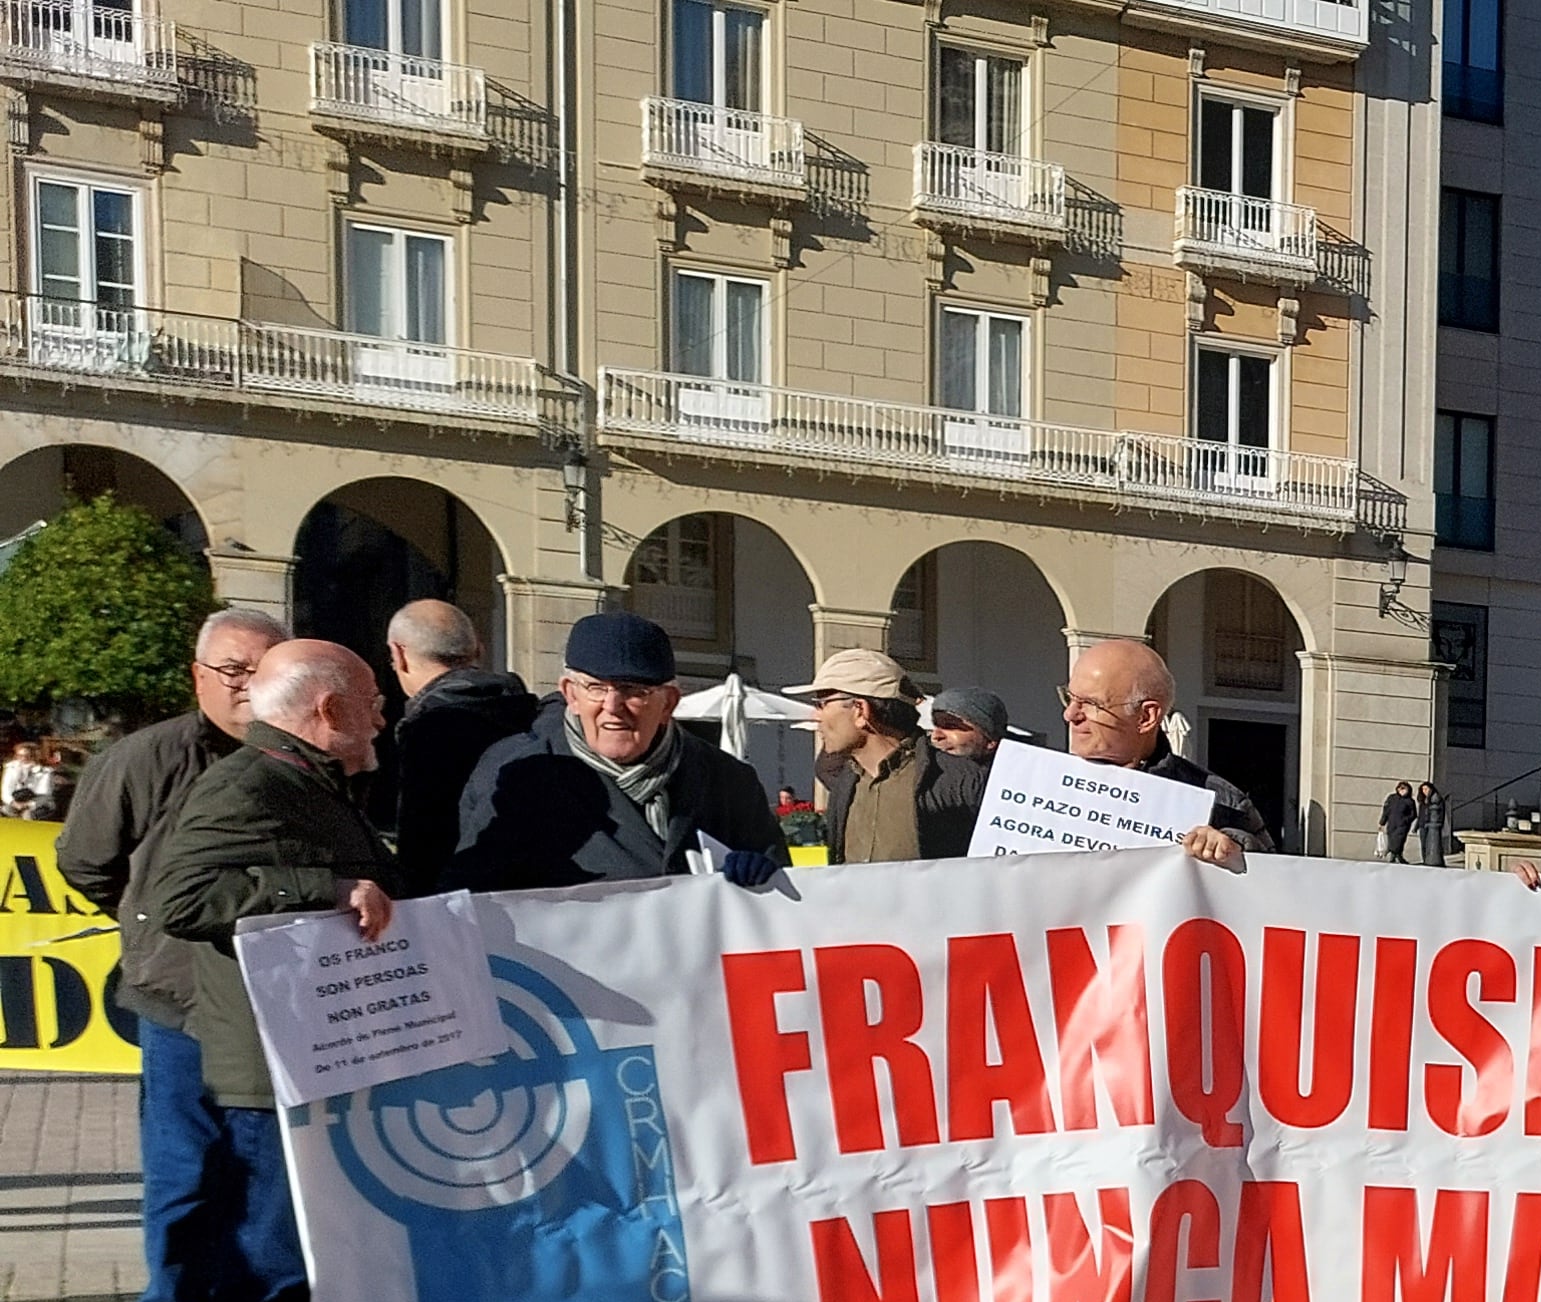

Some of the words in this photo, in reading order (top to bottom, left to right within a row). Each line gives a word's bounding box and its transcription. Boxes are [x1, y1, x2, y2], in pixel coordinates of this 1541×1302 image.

[1061, 774, 1142, 804] DESPOIS
[989, 815, 1055, 842] AGORA
[1000, 788, 1027, 804] DO
[1032, 796, 1082, 818] PAZO
[1087, 809, 1112, 826] DE
[1116, 816, 1186, 846] MEIRÁS
[318, 954, 342, 969] OS
[345, 938, 410, 963] FRANCO
[315, 979, 352, 999] SON
[354, 963, 429, 990] PERSOAS
[326, 1001, 364, 1025] NON
[366, 990, 431, 1016] GRATAS
[404, 1010, 457, 1030] Municipal
